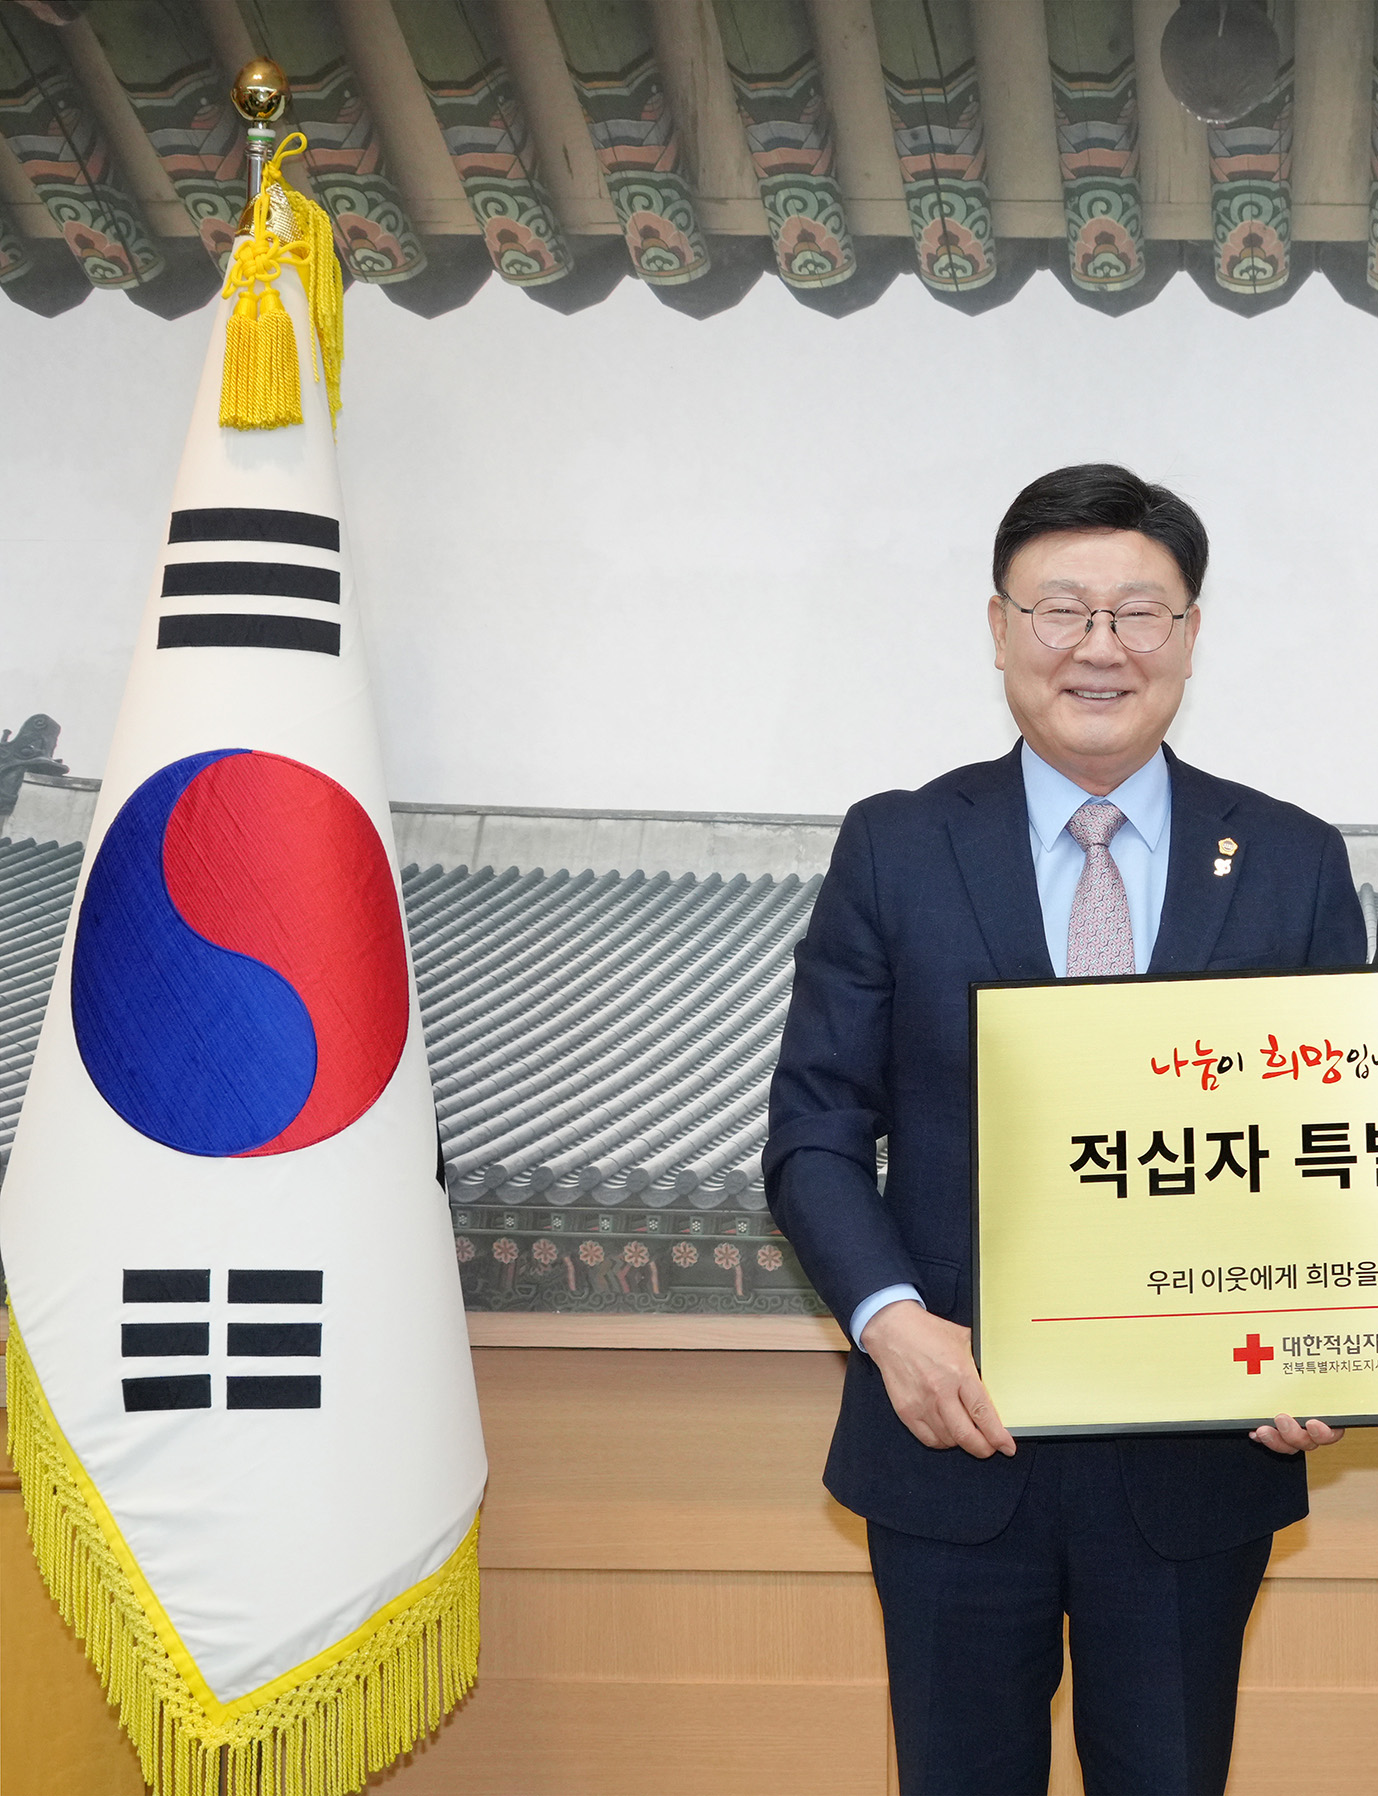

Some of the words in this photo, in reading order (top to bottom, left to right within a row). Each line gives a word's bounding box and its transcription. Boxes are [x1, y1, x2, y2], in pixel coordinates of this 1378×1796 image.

[1151, 1039, 1244, 1091] 나눔이
[1068, 1124, 1270, 1199] 적십자
[1147, 1268, 1194, 1295] 우리
[1201, 1264, 1298, 1293] 이웃에게
[1306, 1260, 1378, 1289] 희망을
